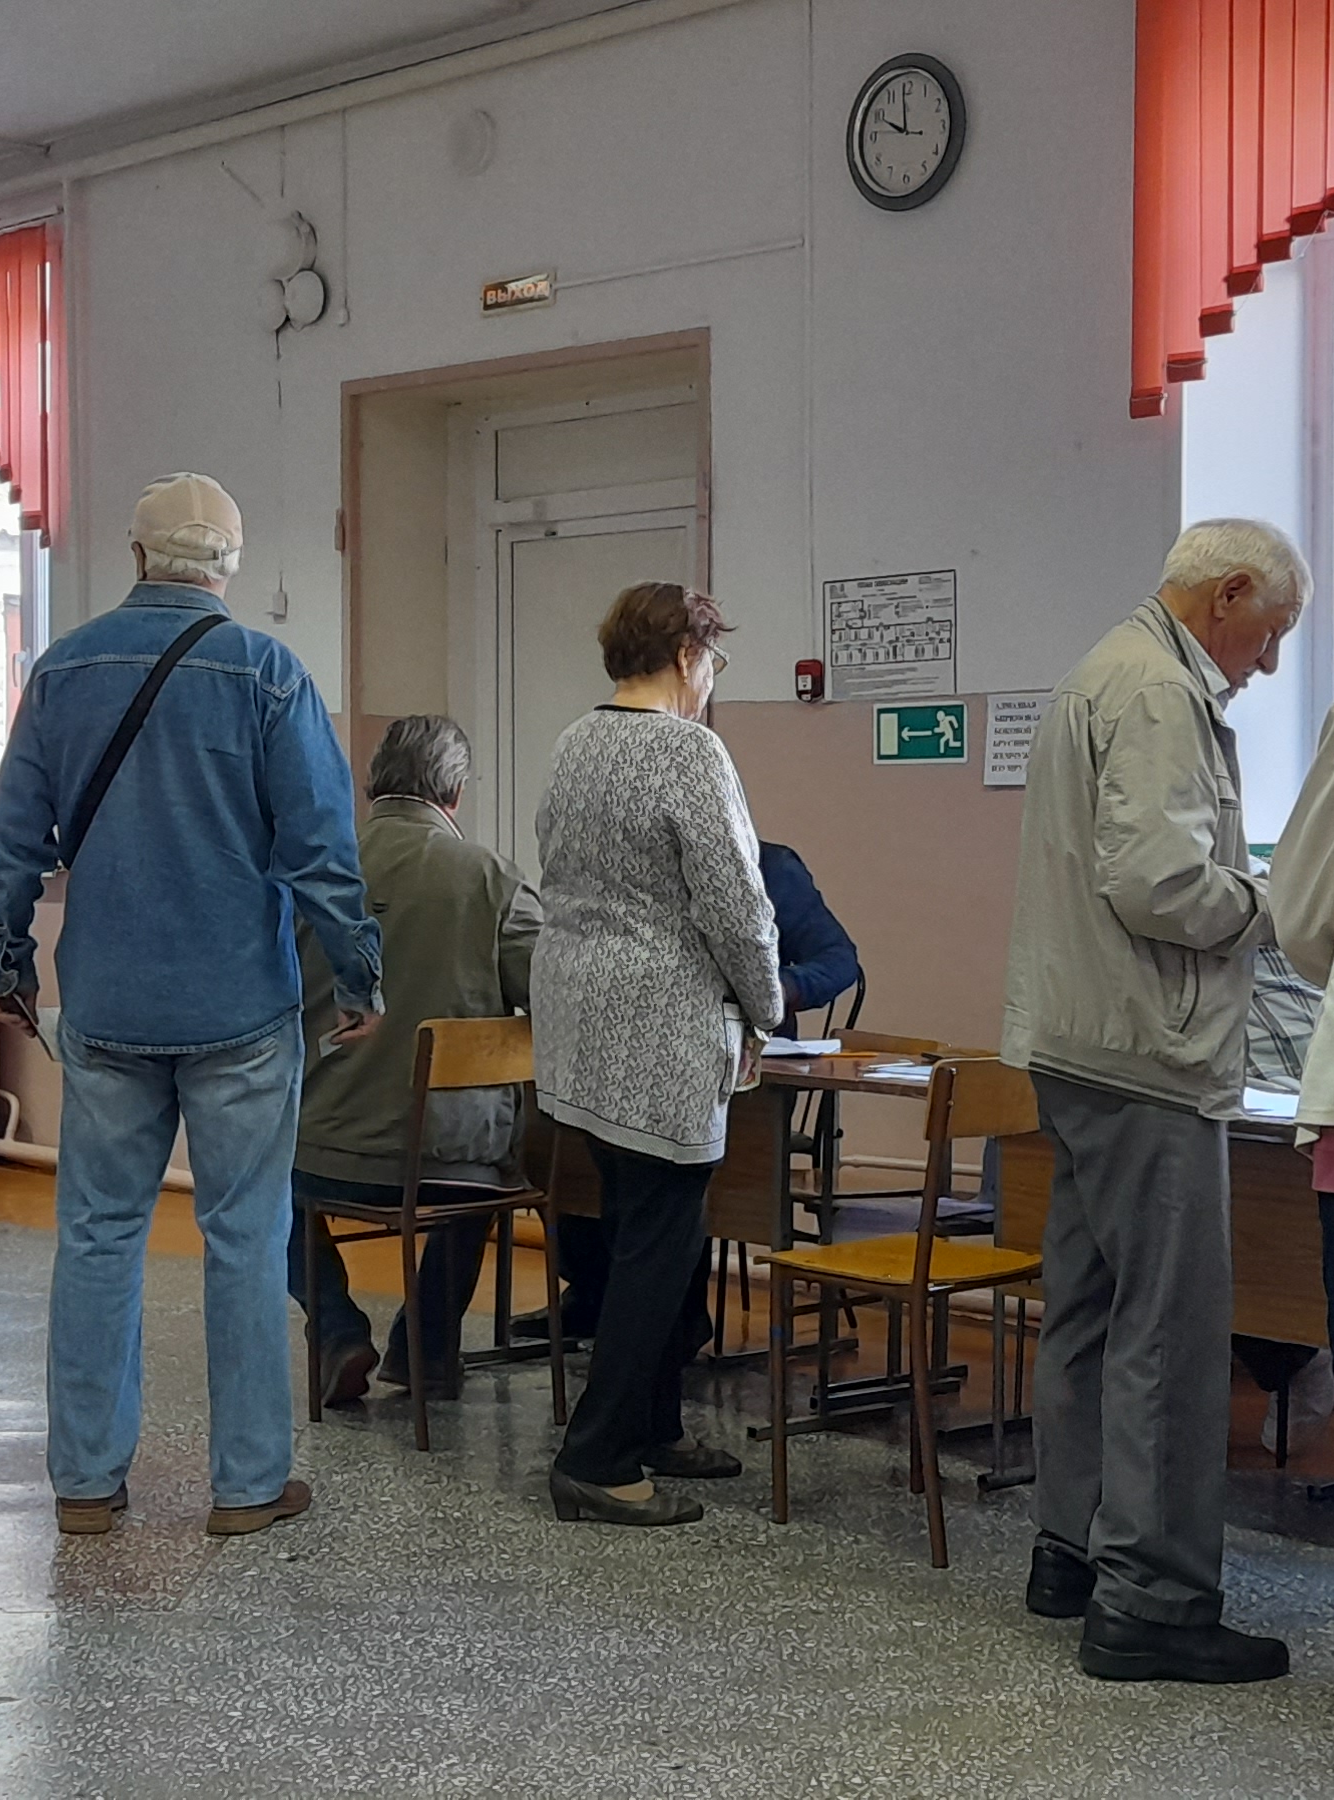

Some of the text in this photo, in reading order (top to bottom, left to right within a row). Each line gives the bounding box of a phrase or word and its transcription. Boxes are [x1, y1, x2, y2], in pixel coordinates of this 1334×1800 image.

[886, 88, 896, 104] 11
[934, 98, 942, 113] 2
[869, 131, 878, 144] 9
[887, 165, 893, 180] 7
[921, 160, 928, 175] 5
[486, 280, 549, 305] ВЫХОД
